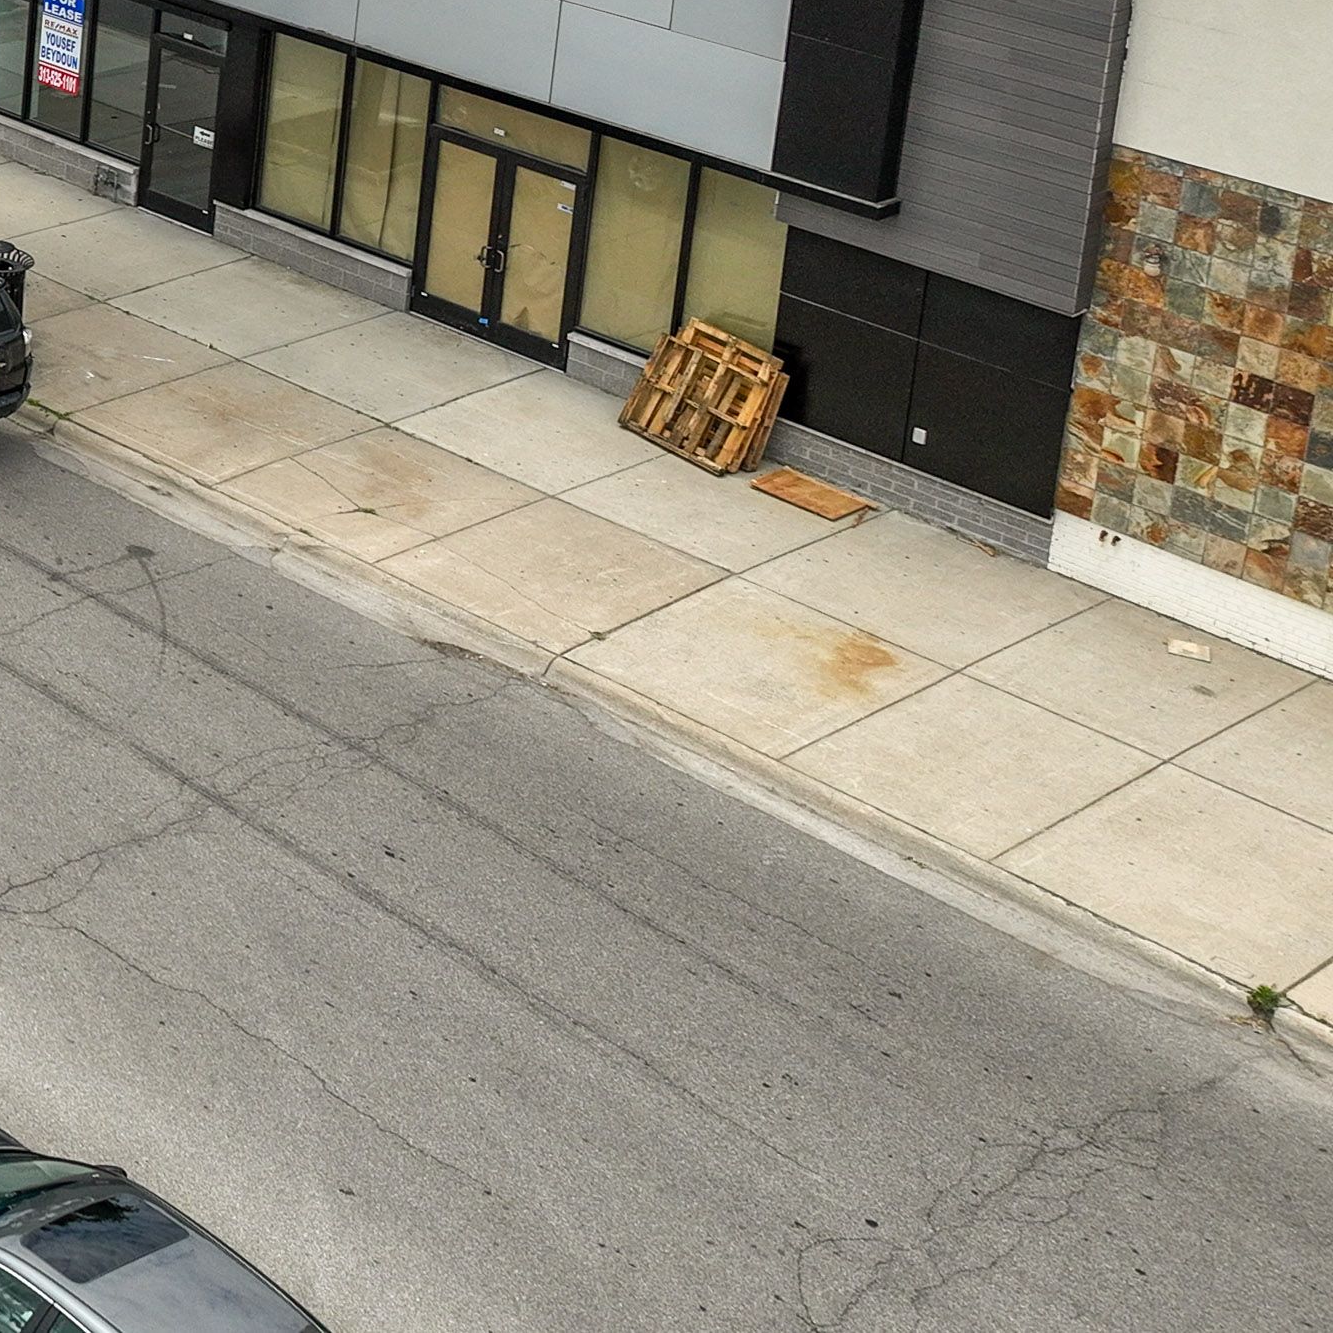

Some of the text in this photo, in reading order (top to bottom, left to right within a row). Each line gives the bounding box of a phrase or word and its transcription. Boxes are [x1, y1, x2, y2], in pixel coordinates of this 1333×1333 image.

[44, 1, 83, 23] LEASE
[44, 19, 78, 35] RE/MAX
[45, 31, 76, 53] YOUSEF
[41, 45, 78, 69] BEYDOUN
[38, 66, 77, 93] 313-525-1101
